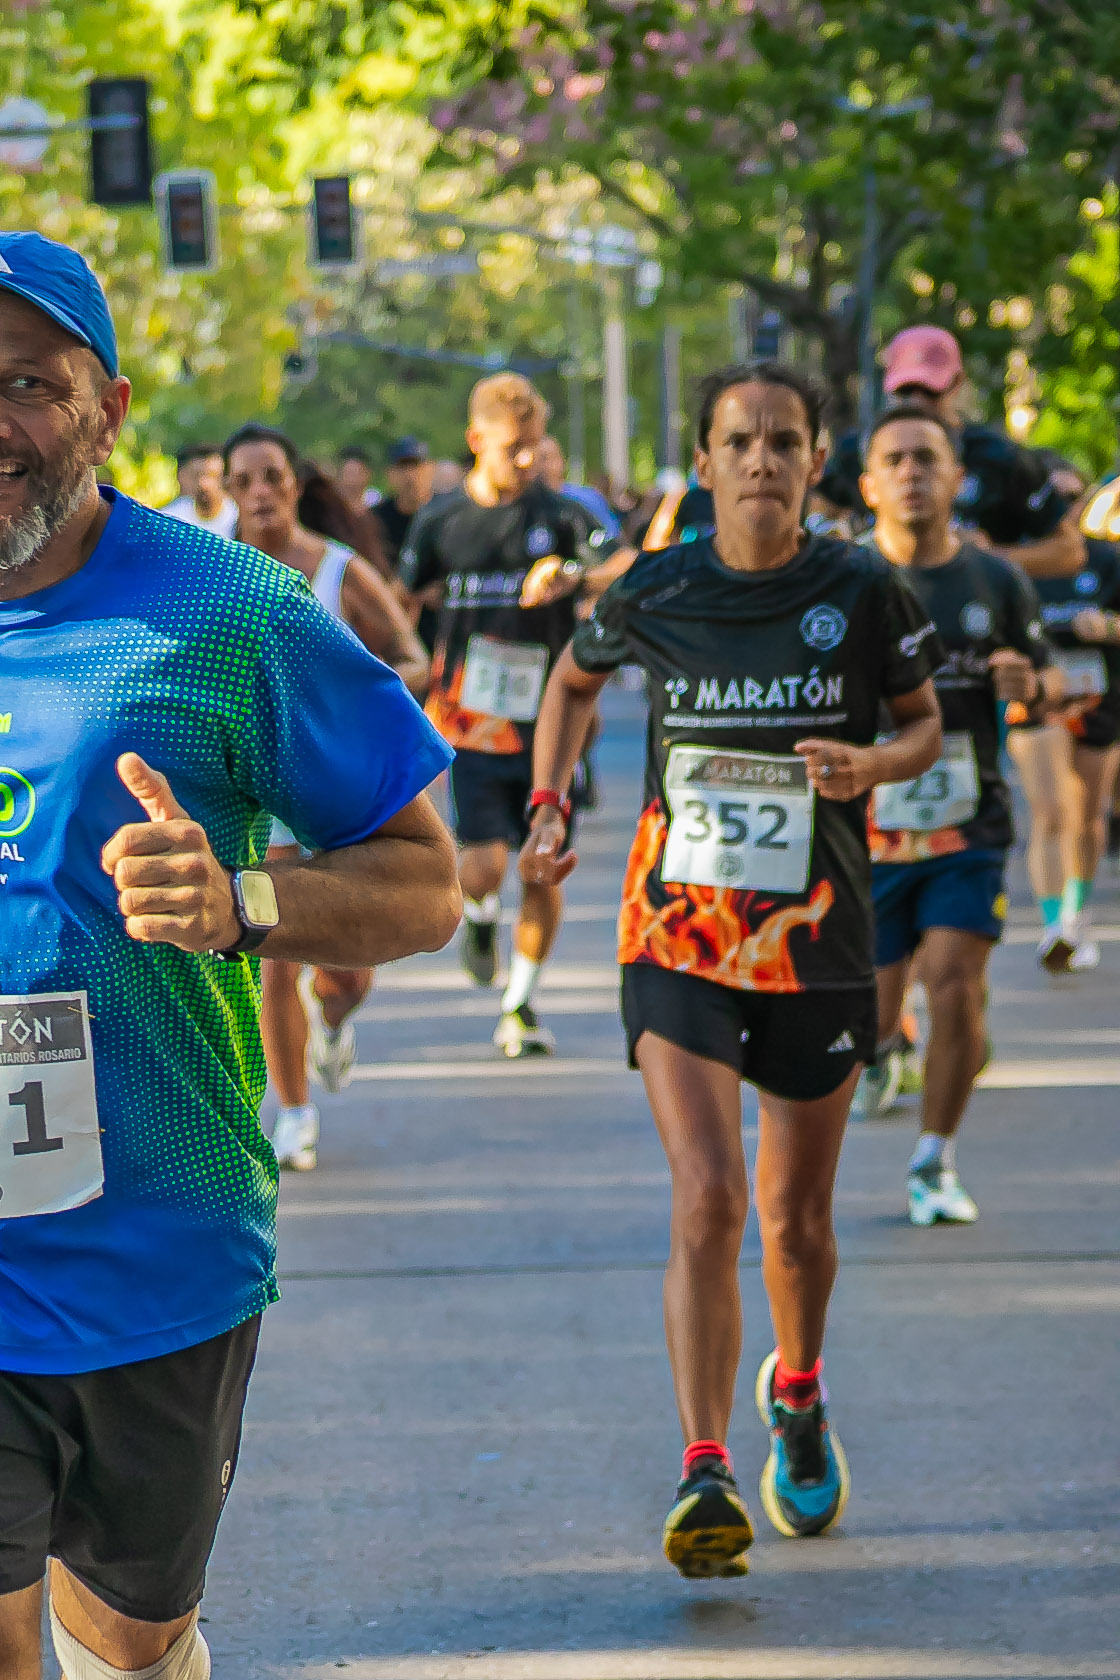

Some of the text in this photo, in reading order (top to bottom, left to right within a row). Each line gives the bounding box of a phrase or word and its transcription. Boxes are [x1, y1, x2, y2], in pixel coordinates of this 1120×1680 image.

[694, 664, 844, 710] MARATÓN
[684, 799, 791, 850] 352
[38, 1047, 82, 1063] ROSARIO
